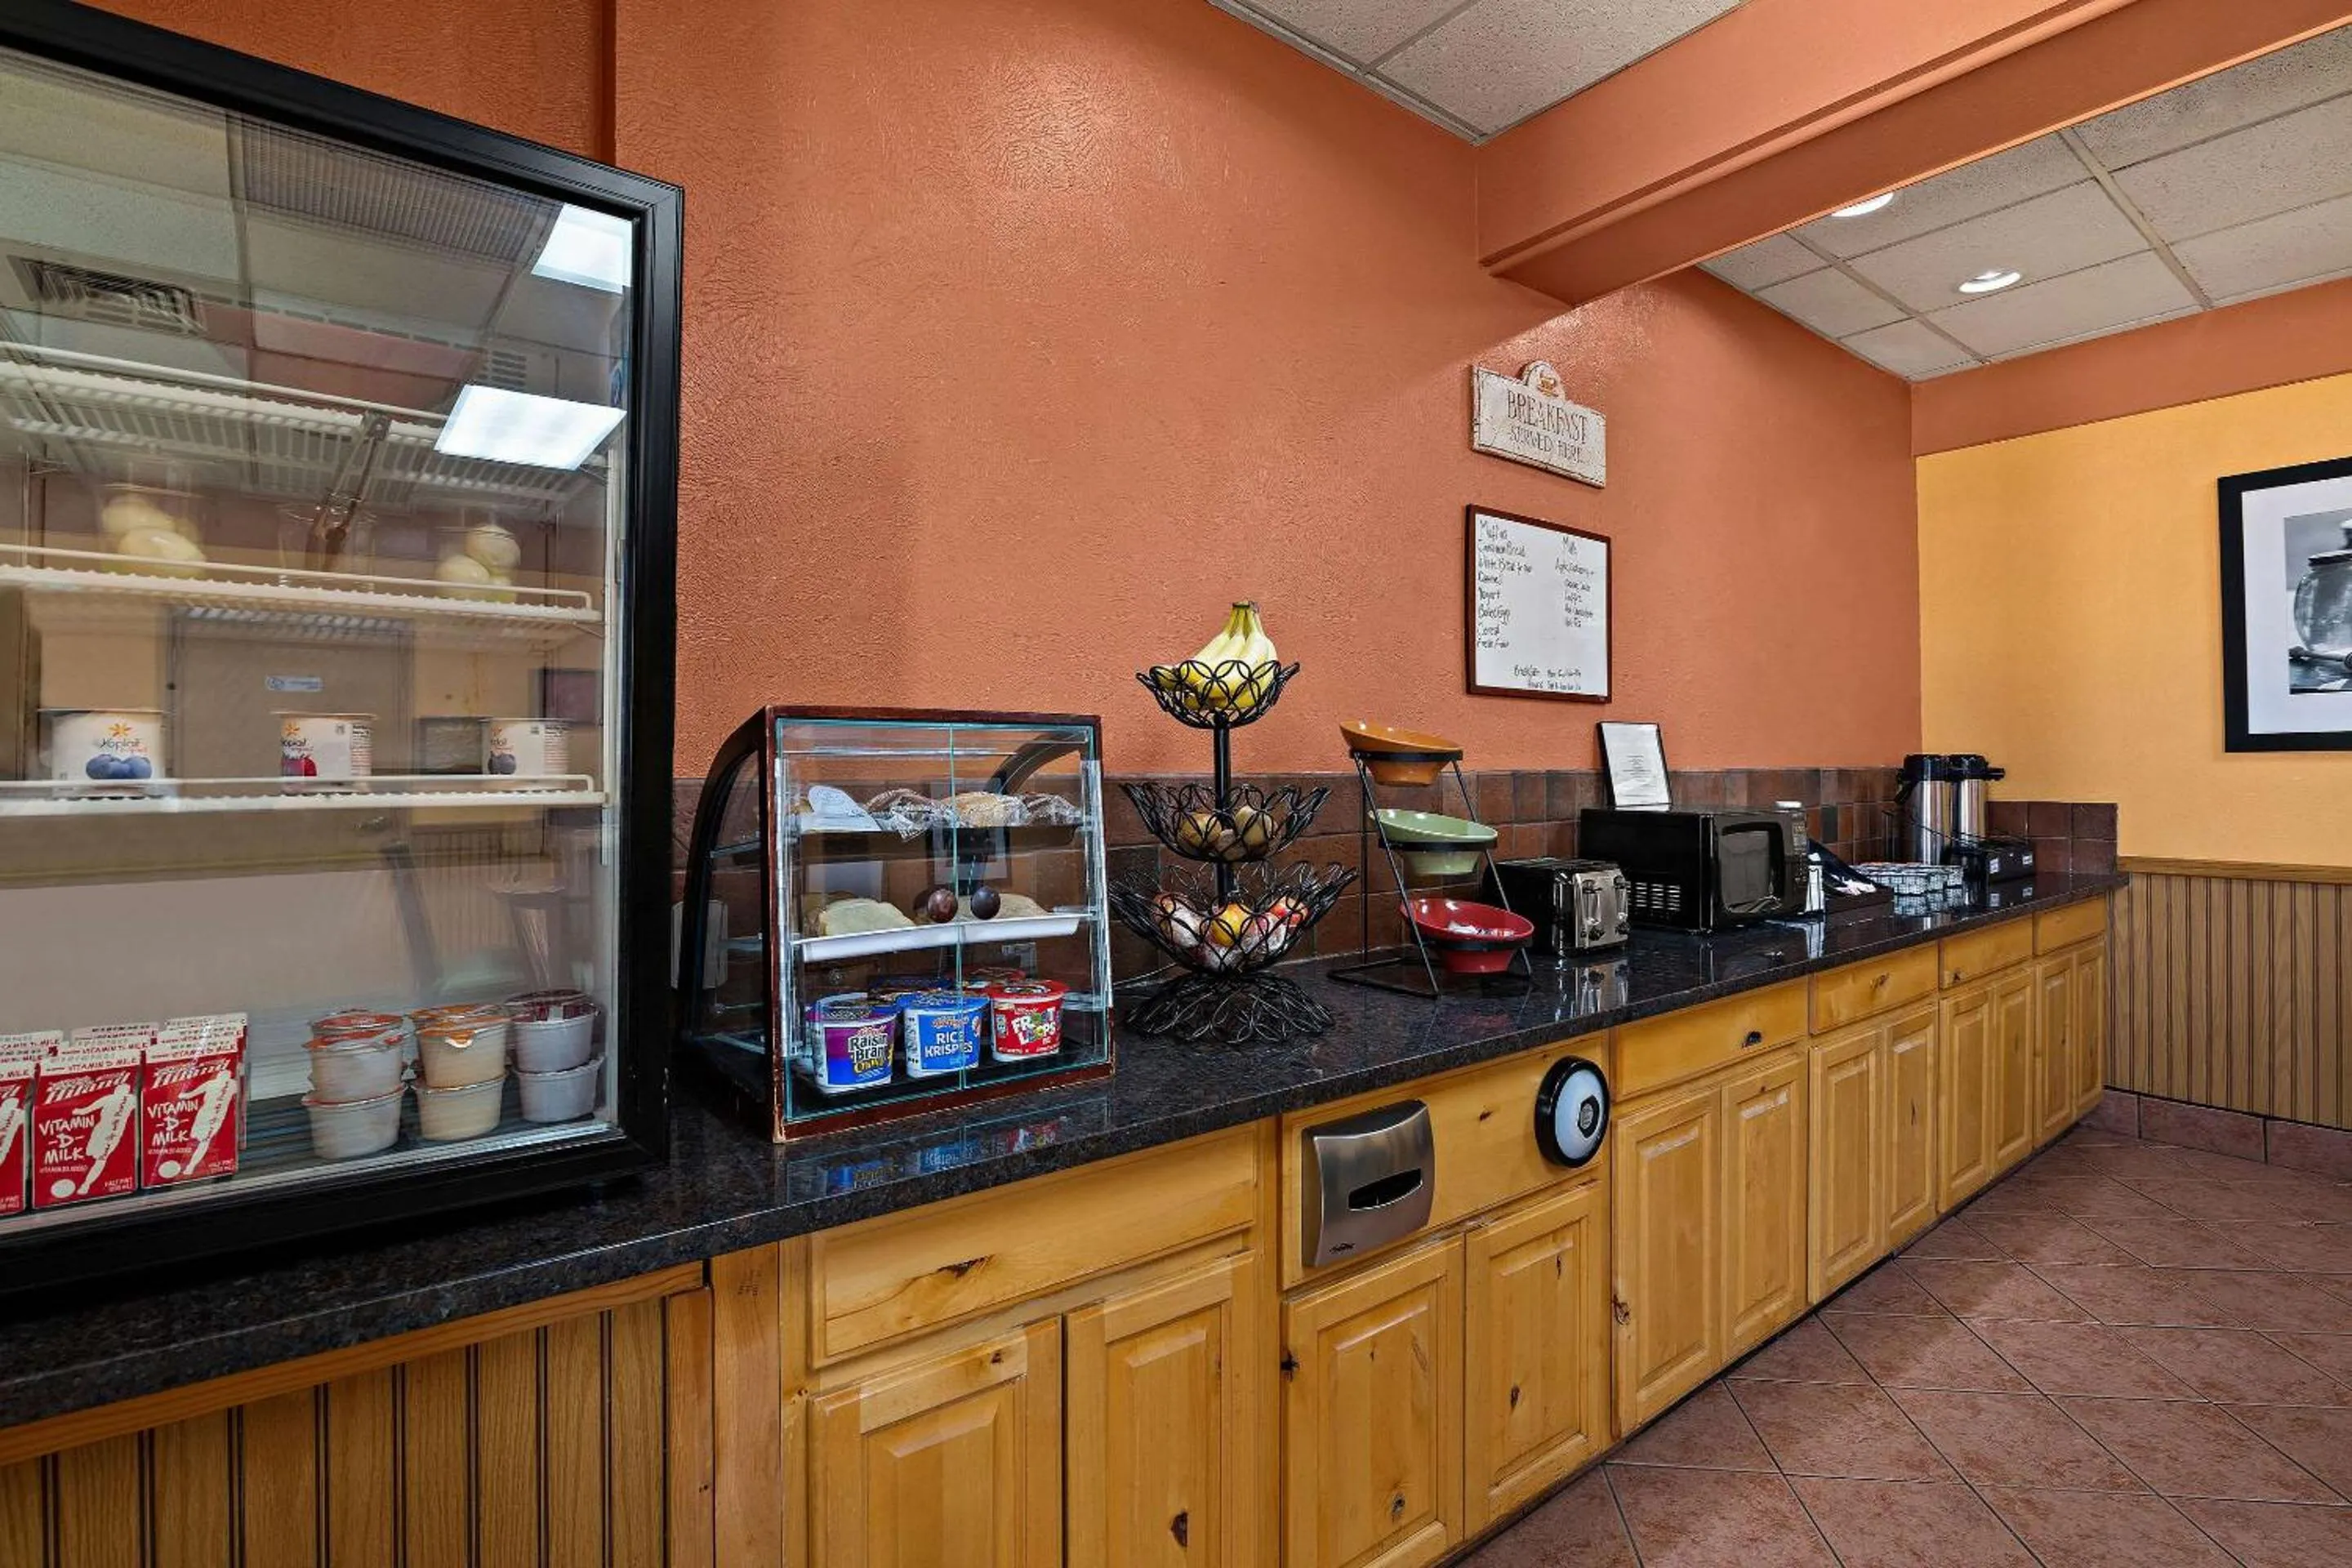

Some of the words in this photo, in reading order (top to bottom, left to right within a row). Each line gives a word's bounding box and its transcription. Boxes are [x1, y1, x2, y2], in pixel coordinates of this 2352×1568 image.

[1508, 390, 1588, 444] BREAKFAST
[1511, 425, 1553, 452] SERVED
[147, 1099, 199, 1120] VITAMIN
[39, 1116, 95, 1137] VITAMIN
[152, 1129, 189, 1147] MILK
[44, 1147, 86, 1165] MILK
